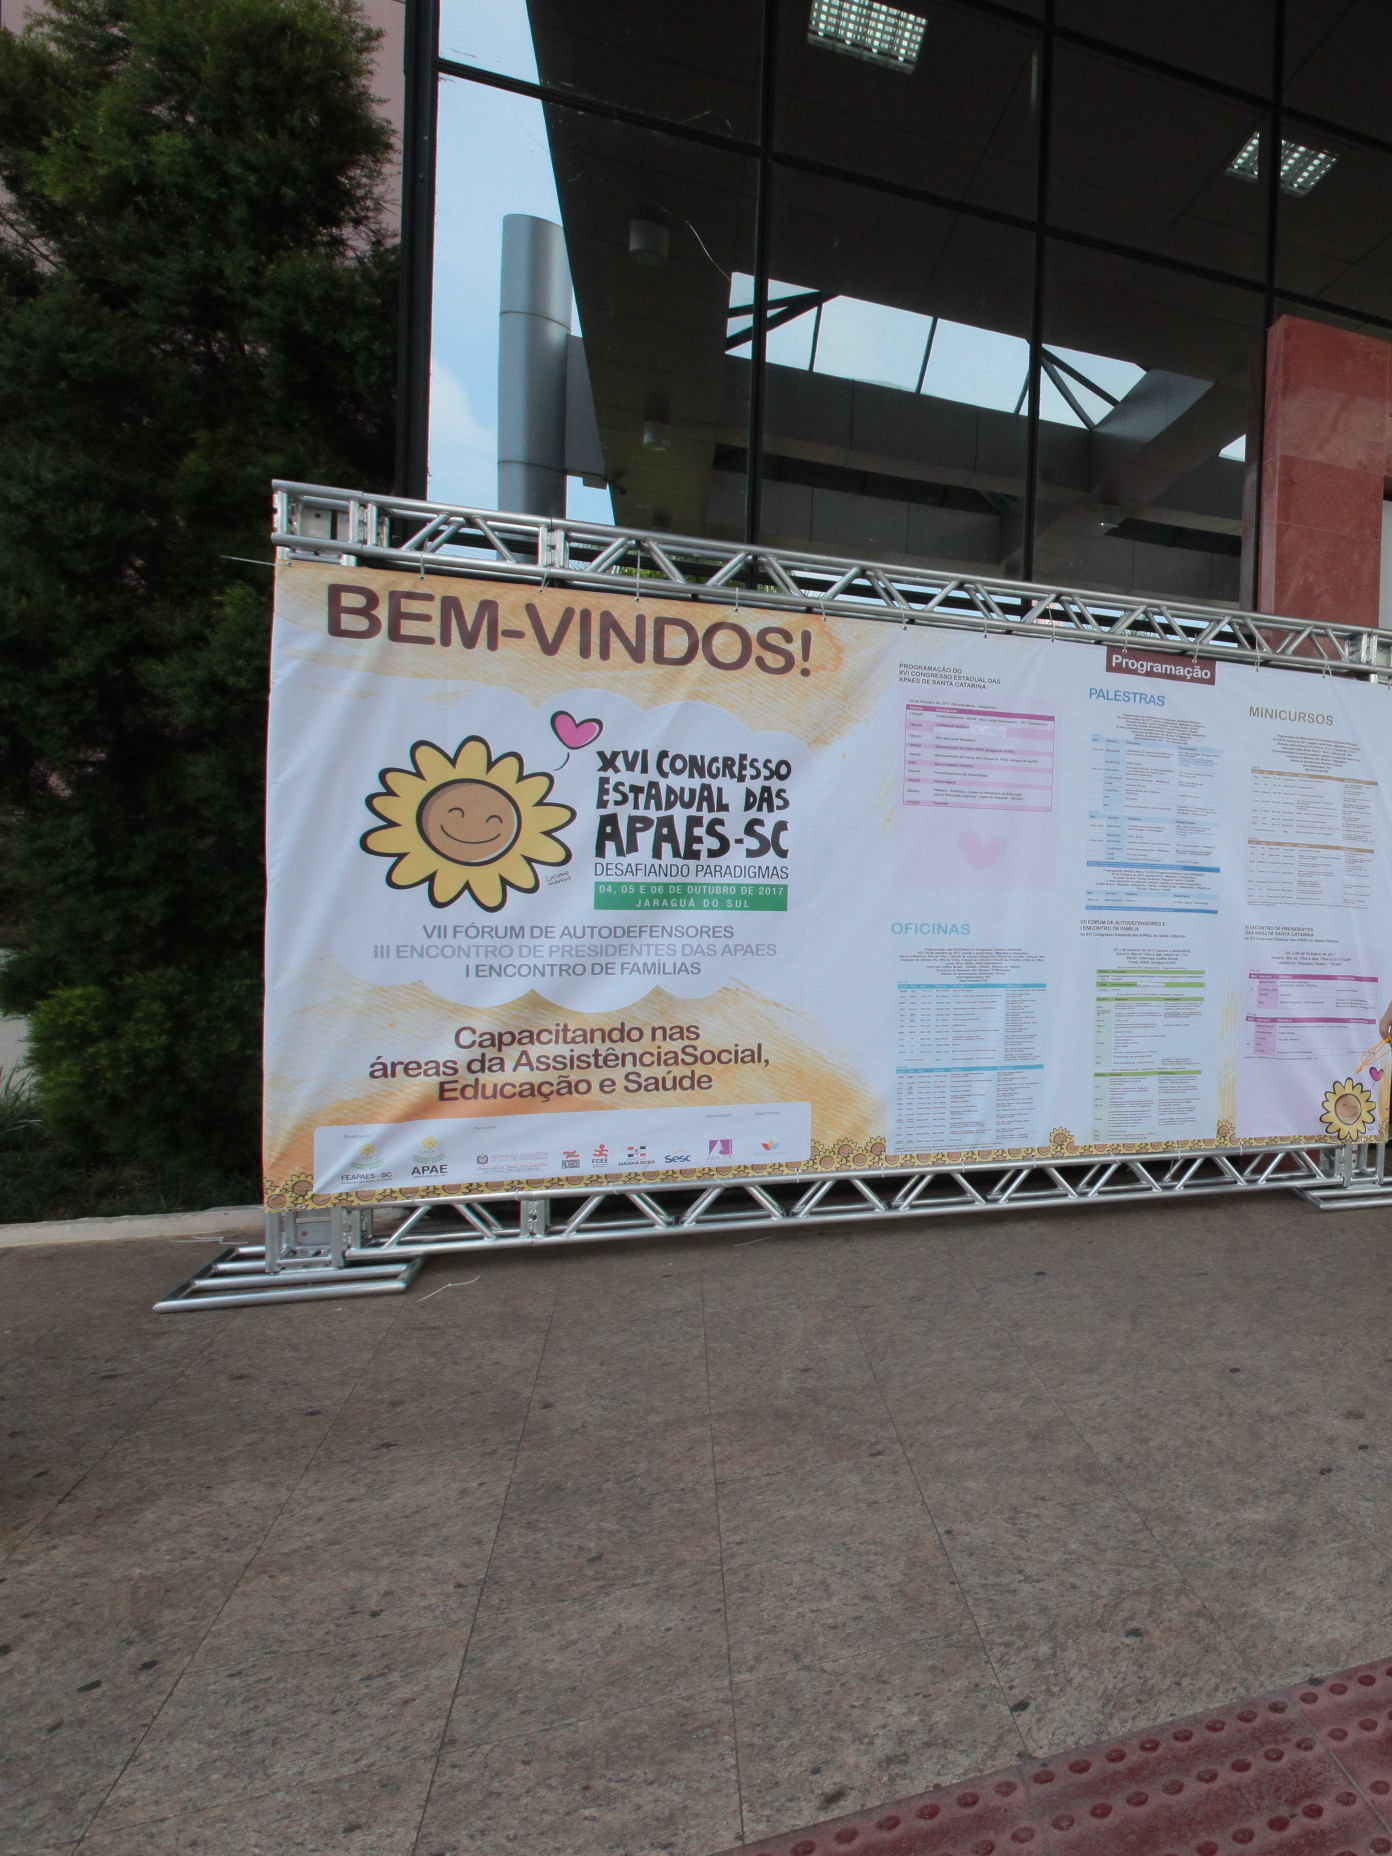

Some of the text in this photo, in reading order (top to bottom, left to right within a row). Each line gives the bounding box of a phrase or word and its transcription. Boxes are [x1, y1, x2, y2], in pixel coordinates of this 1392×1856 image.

[328, 583, 811, 677] BEM-VINDOS!
[899, 663, 951, 674] PROGRAMAÇÃO
[1111, 654, 1211, 680] Programação
[910, 671, 952, 680] CONGRESSO
[953, 675, 986, 683] ESTADUAL
[955, 681, 986, 690] CATARINA
[1089, 687, 1165, 707] PALESTRAS
[1249, 706, 1333, 726] MINICURSOS
[596, 749, 791, 782] XVI CONGRESSO
[596, 776, 790, 813] ESTADUAL DAS
[595, 813, 789, 860] APAES-SC
[594, 862, 789, 879] DESAFIANDO PARADIGMAS
[599, 885, 784, 895] 04, 05 E 06 DE OUTUBRO DE 2017
[636, 897, 750, 908] JARAGUÁ DO SUL
[422, 922, 734, 939] VII FÓRUM DE AUTODEFENSORES
[891, 922, 970, 935] OFICINAS
[374, 943, 777, 959] III ENCONTRO DE PRESIDENTES DAS APAES
[465, 959, 702, 978] I ENCONTRO DE FAMÍLIAS
[454, 1022, 700, 1052] Capacitando nas
[368, 1043, 770, 1079] áreas da AssistênciaSocial,
[438, 1070, 713, 1102] Educação e Saúde
[411, 1164, 448, 1175] APAE
